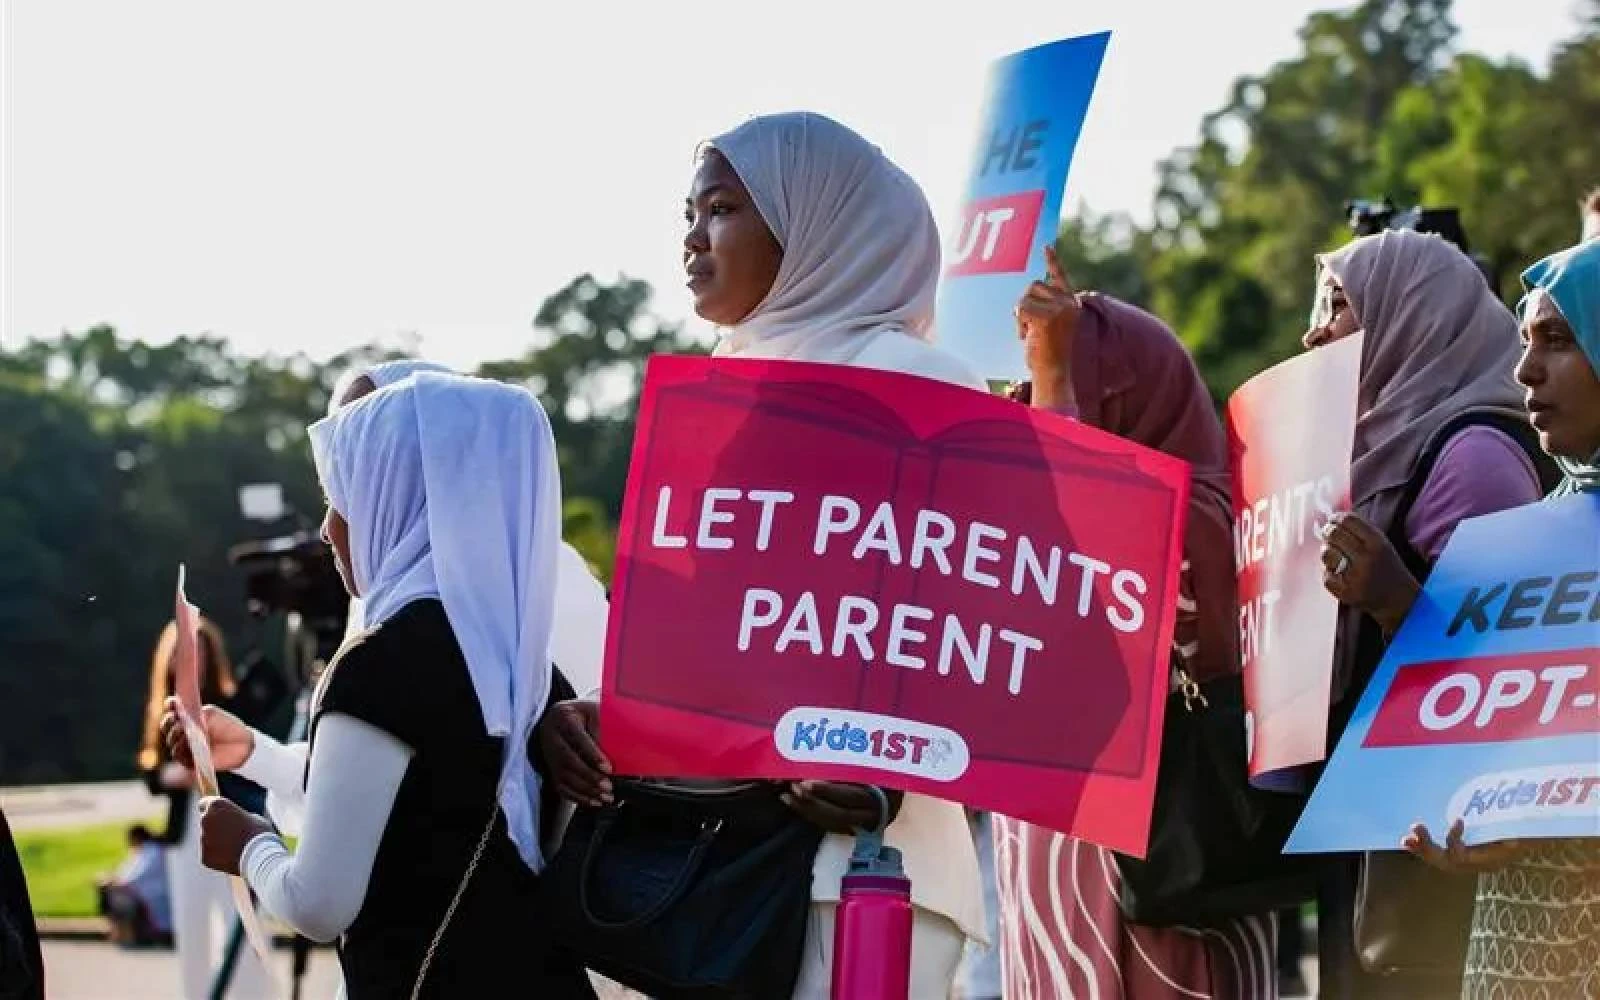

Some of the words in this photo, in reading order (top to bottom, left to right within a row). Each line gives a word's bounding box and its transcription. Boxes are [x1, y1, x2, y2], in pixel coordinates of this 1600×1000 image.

[978, 119, 1049, 176] HE
[652, 485, 794, 551] LET
[812, 495, 1147, 633] PARENTS
[1234, 477, 1334, 572] RENTS
[736, 588, 1044, 695] PARENT
[1418, 665, 1600, 731] OPT-
[791, 717, 929, 765] Kids1ST
